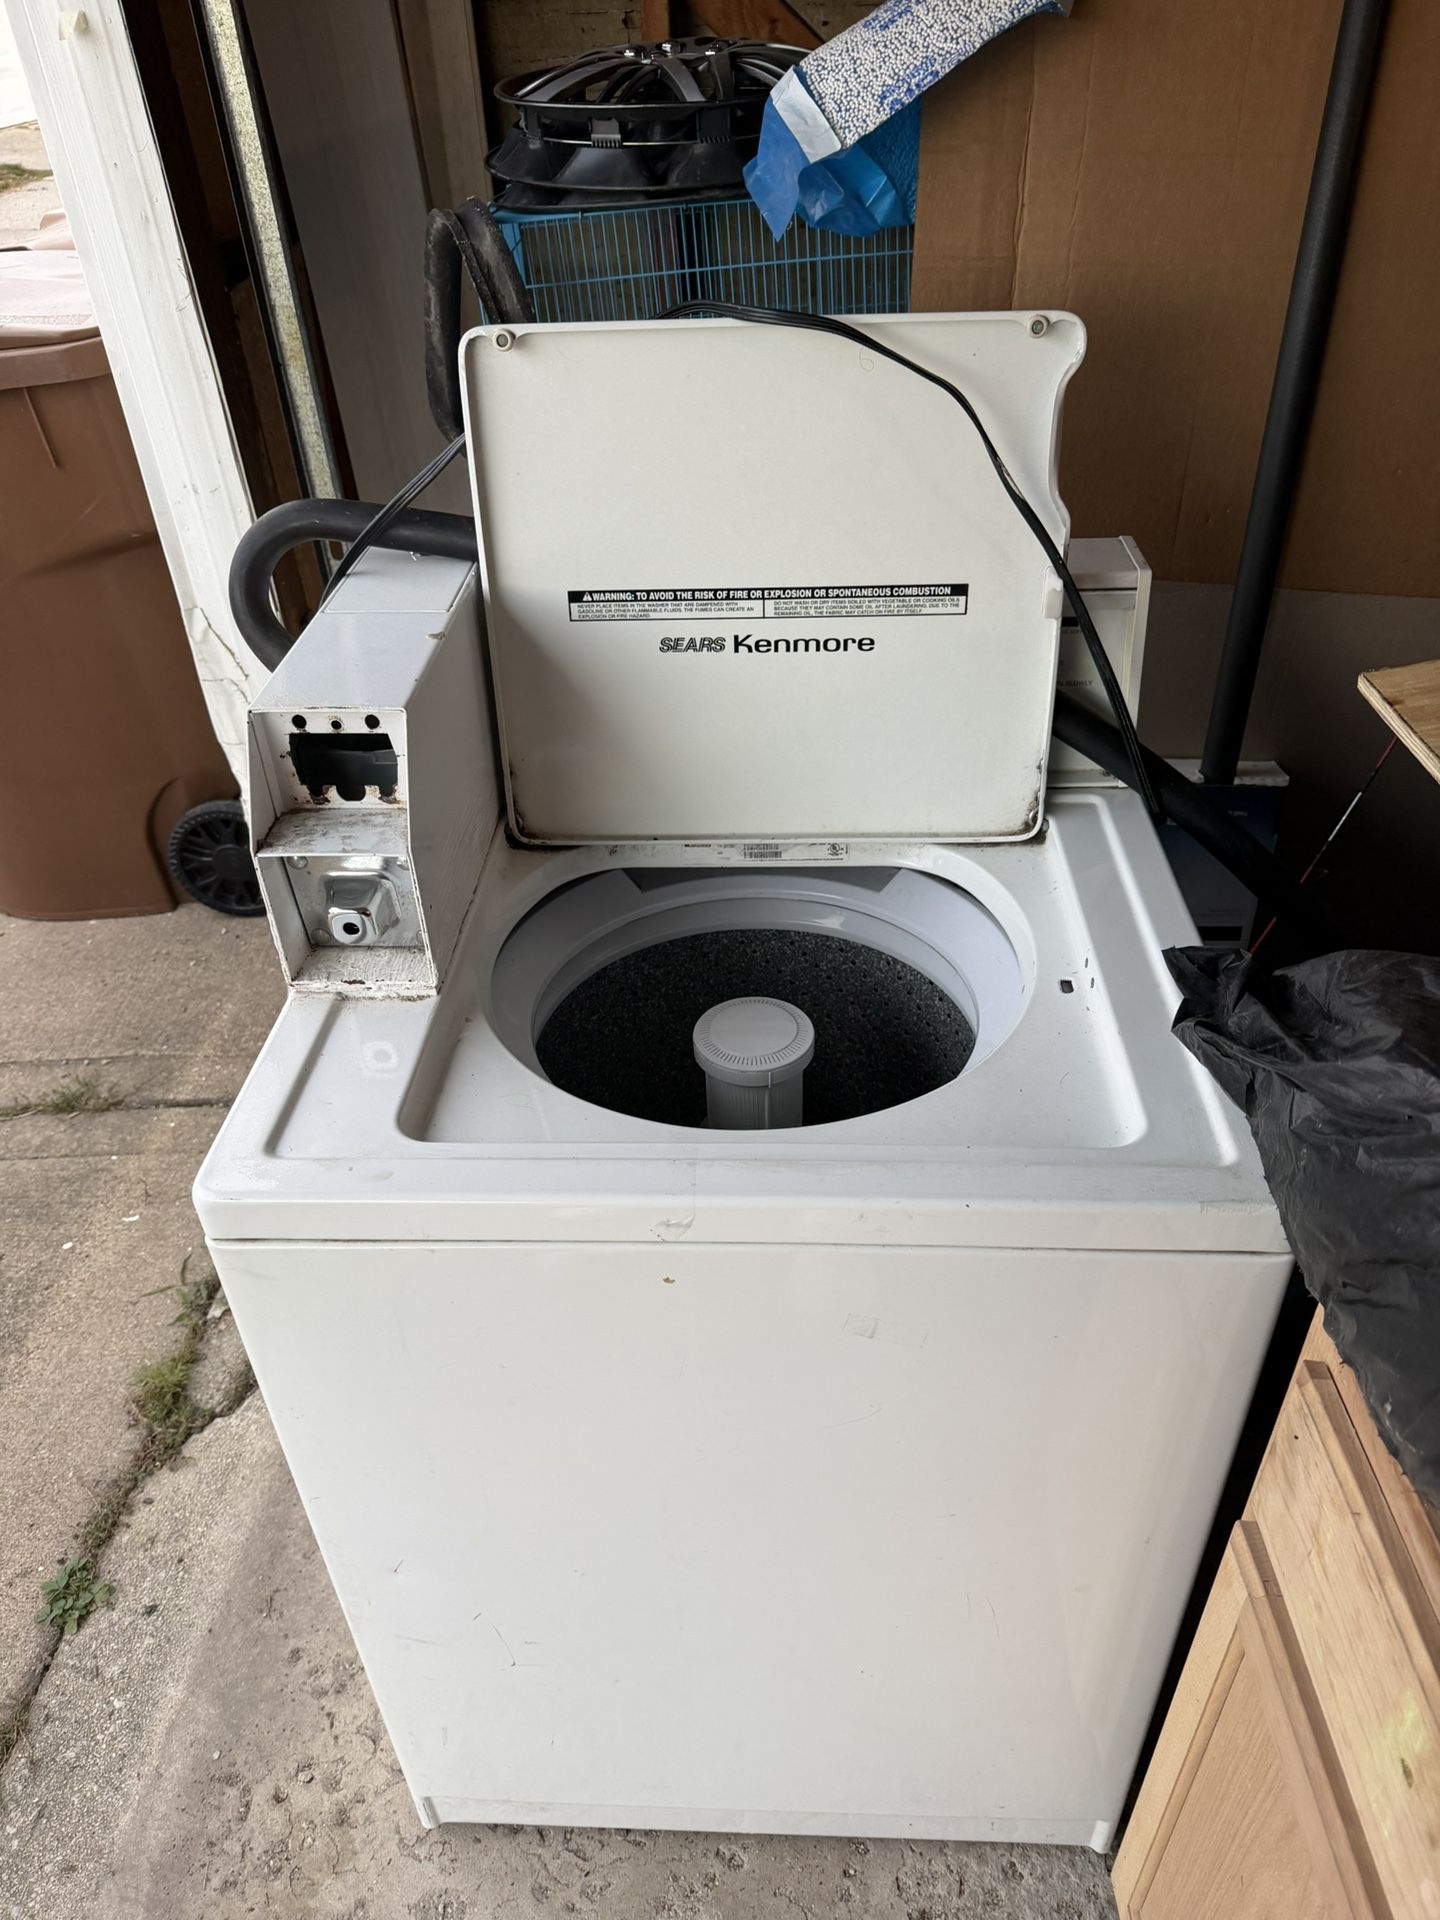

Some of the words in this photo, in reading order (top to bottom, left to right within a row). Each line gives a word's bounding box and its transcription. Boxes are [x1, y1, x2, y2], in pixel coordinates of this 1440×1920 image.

[592, 592, 634, 601] WARNING:
[635, 592, 647, 600] TO
[648, 591, 674, 600] AVOID
[675, 591, 692, 599] THE
[694, 590, 714, 599] RISK
[716, 590, 728, 599] OF
[729, 590, 748, 598] FIRE
[750, 589, 762, 598] OR
[764, 588, 811, 598] EXPLOSION
[813, 588, 826, 597] OR
[827, 587, 891, 596] SPONTANEOUS
[892, 586, 950, 595] COMBUSTION
[659, 637, 726, 653] SEARS
[733, 634, 875, 654] Kenmore
